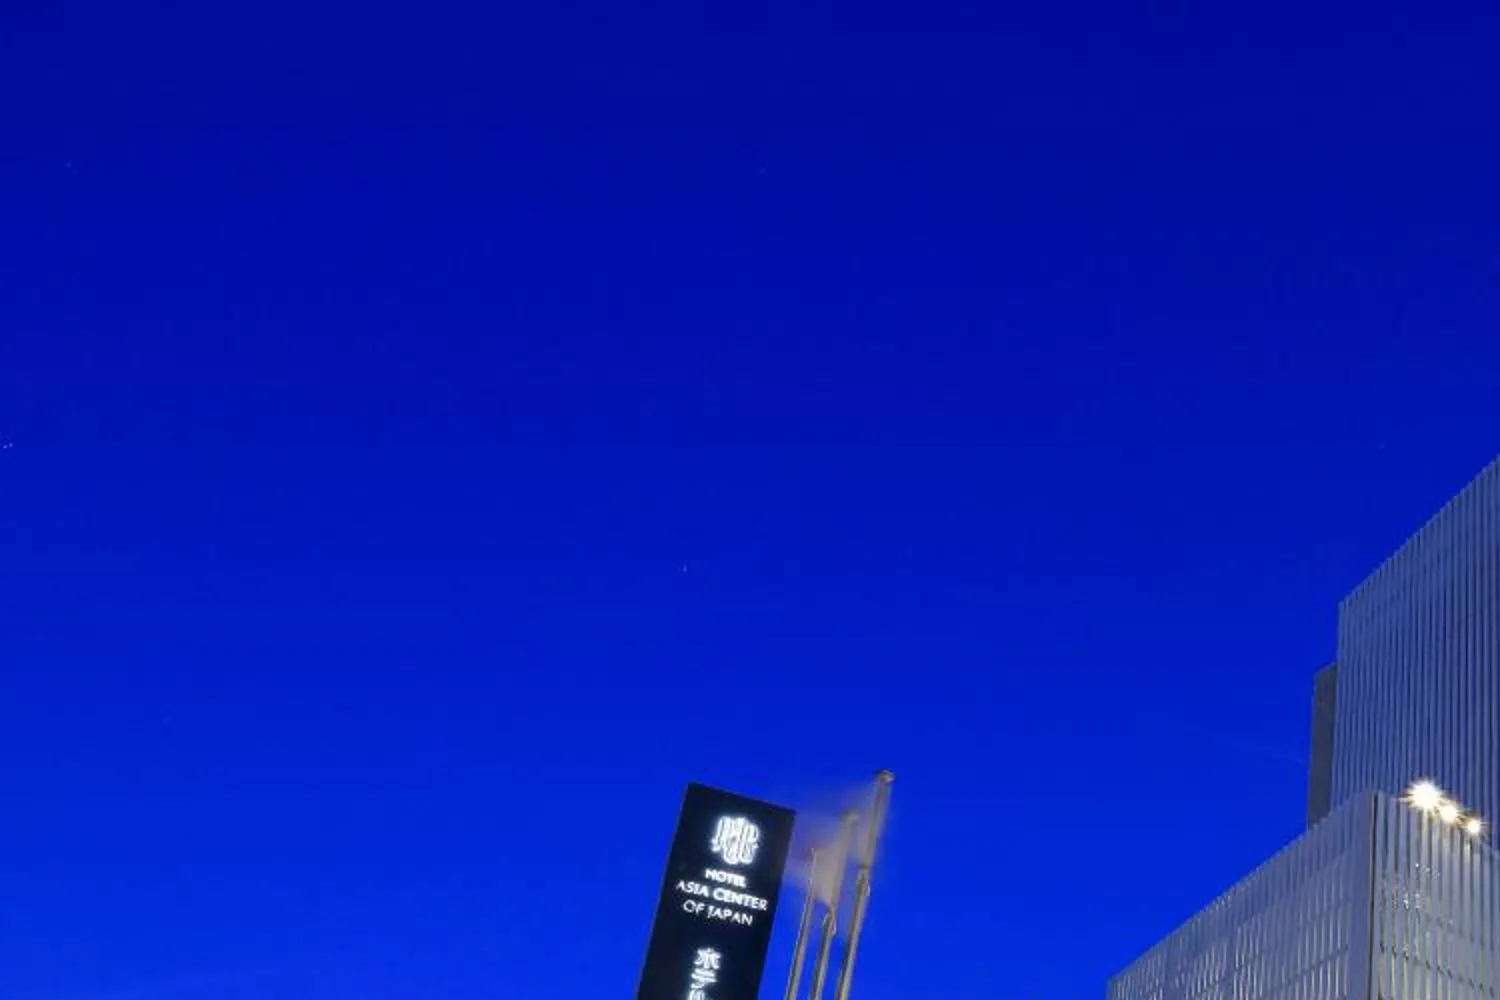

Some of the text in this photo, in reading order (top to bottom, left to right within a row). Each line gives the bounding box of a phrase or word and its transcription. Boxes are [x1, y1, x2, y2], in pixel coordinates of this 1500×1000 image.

[704, 868, 747, 888] HOTEL
[676, 880, 768, 911] ASIA CENTER
[683, 899, 753, 925] OF JAPAN
